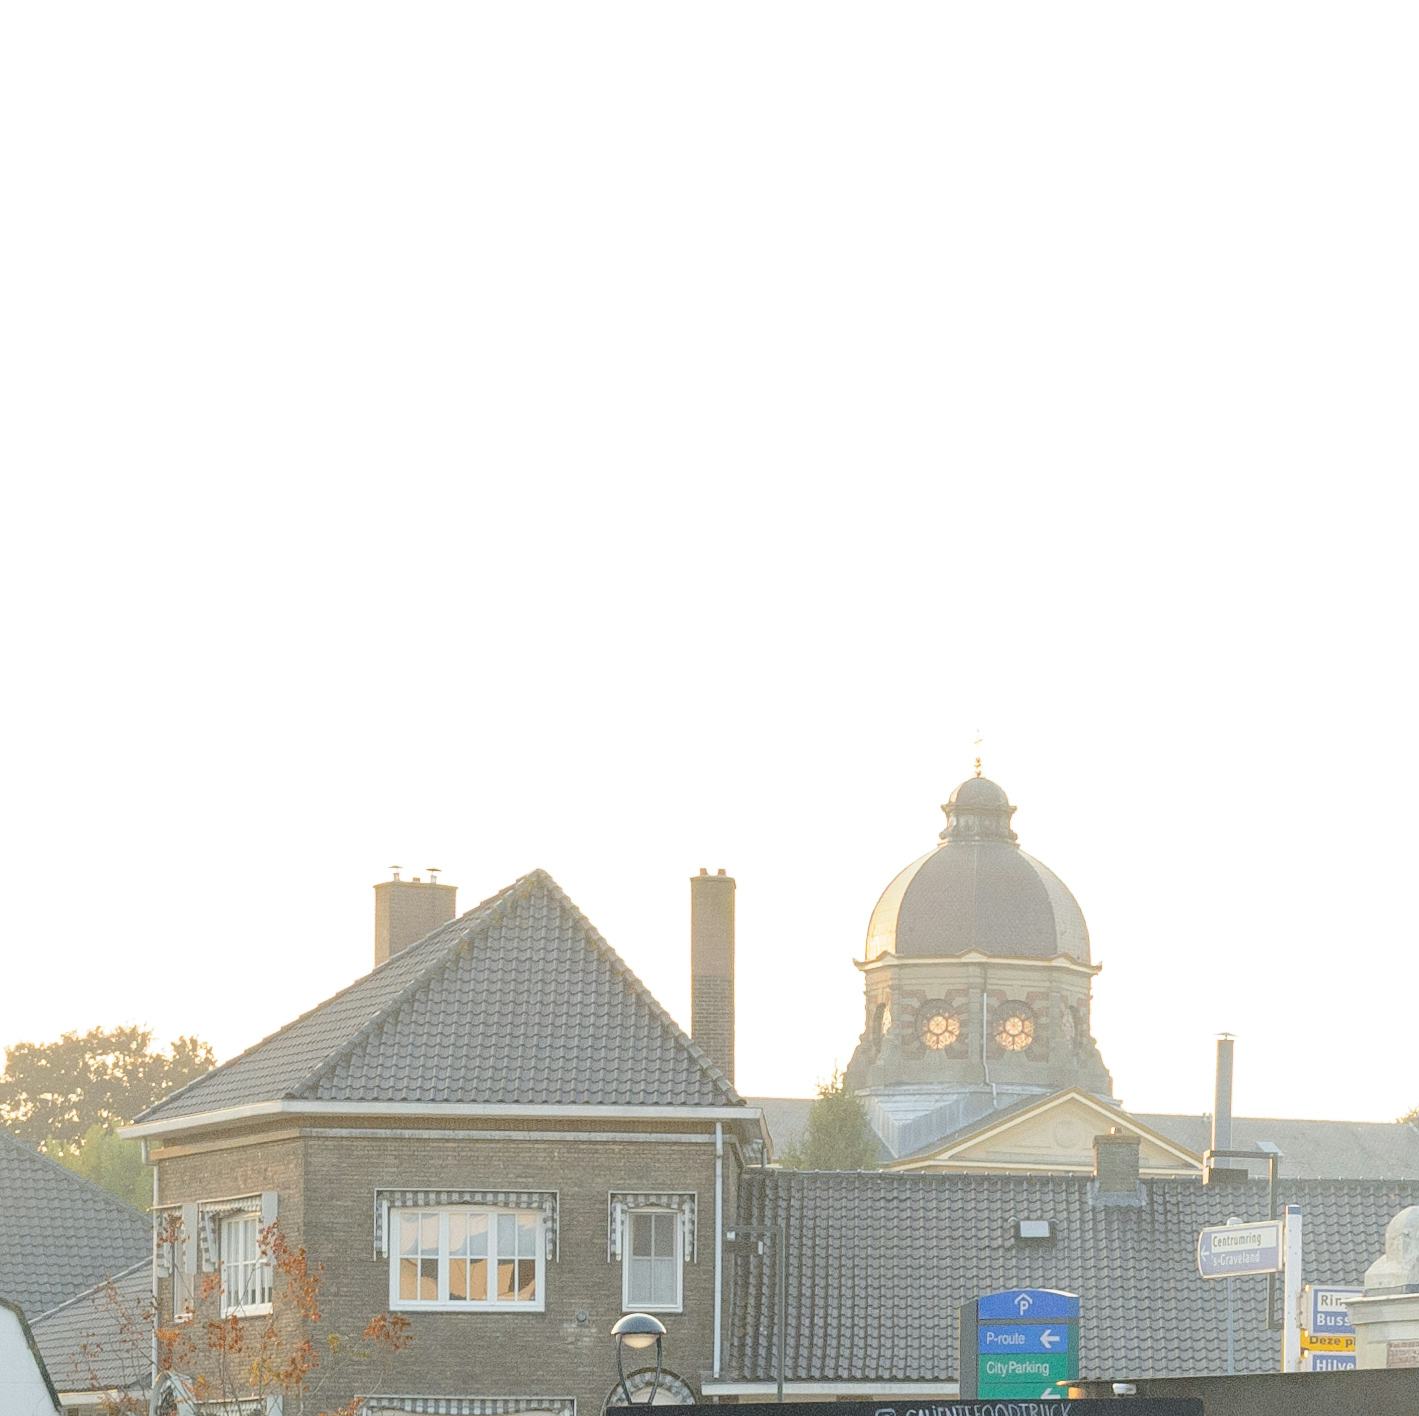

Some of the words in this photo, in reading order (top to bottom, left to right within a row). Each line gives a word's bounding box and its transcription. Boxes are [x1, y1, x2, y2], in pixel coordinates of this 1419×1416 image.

[1212, 1232, 1262, 1248] Centrumring
[1213, 1251, 1260, 1267] 's-Graveland
[1320, 1295, 1346, 1308] Rin
[1317, 1313, 1351, 1326] Buss
[986, 1332, 1025, 1345] P-route
[1309, 1335, 1345, 1345] Deze
[1316, 1359, 1355, 1372] Hilve
